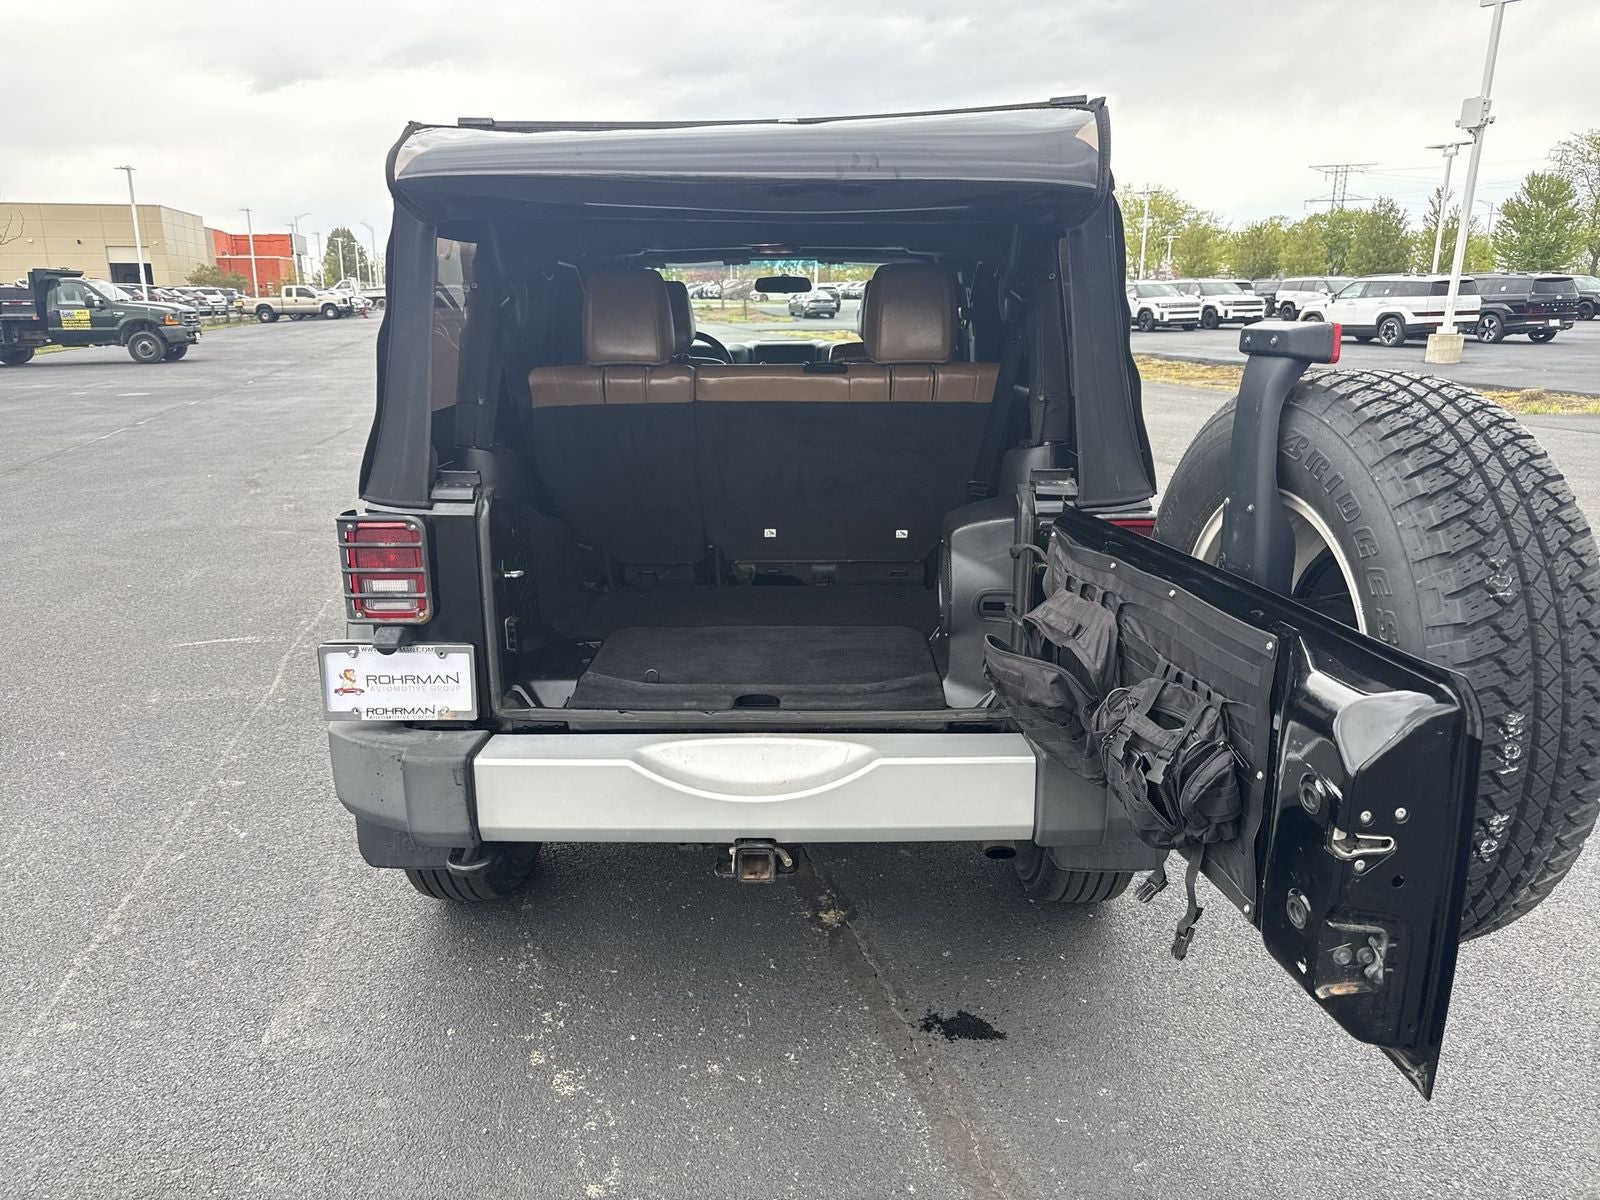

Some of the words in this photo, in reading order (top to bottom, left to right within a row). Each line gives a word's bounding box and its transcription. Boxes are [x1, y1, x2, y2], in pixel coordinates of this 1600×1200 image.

[1280, 428, 1400, 645] BRIDGES
[365, 671, 460, 688] ROHRMAN
[369, 685, 428, 693] AUTOMOTIVE
[366, 704, 436, 717] ROHRMAN
